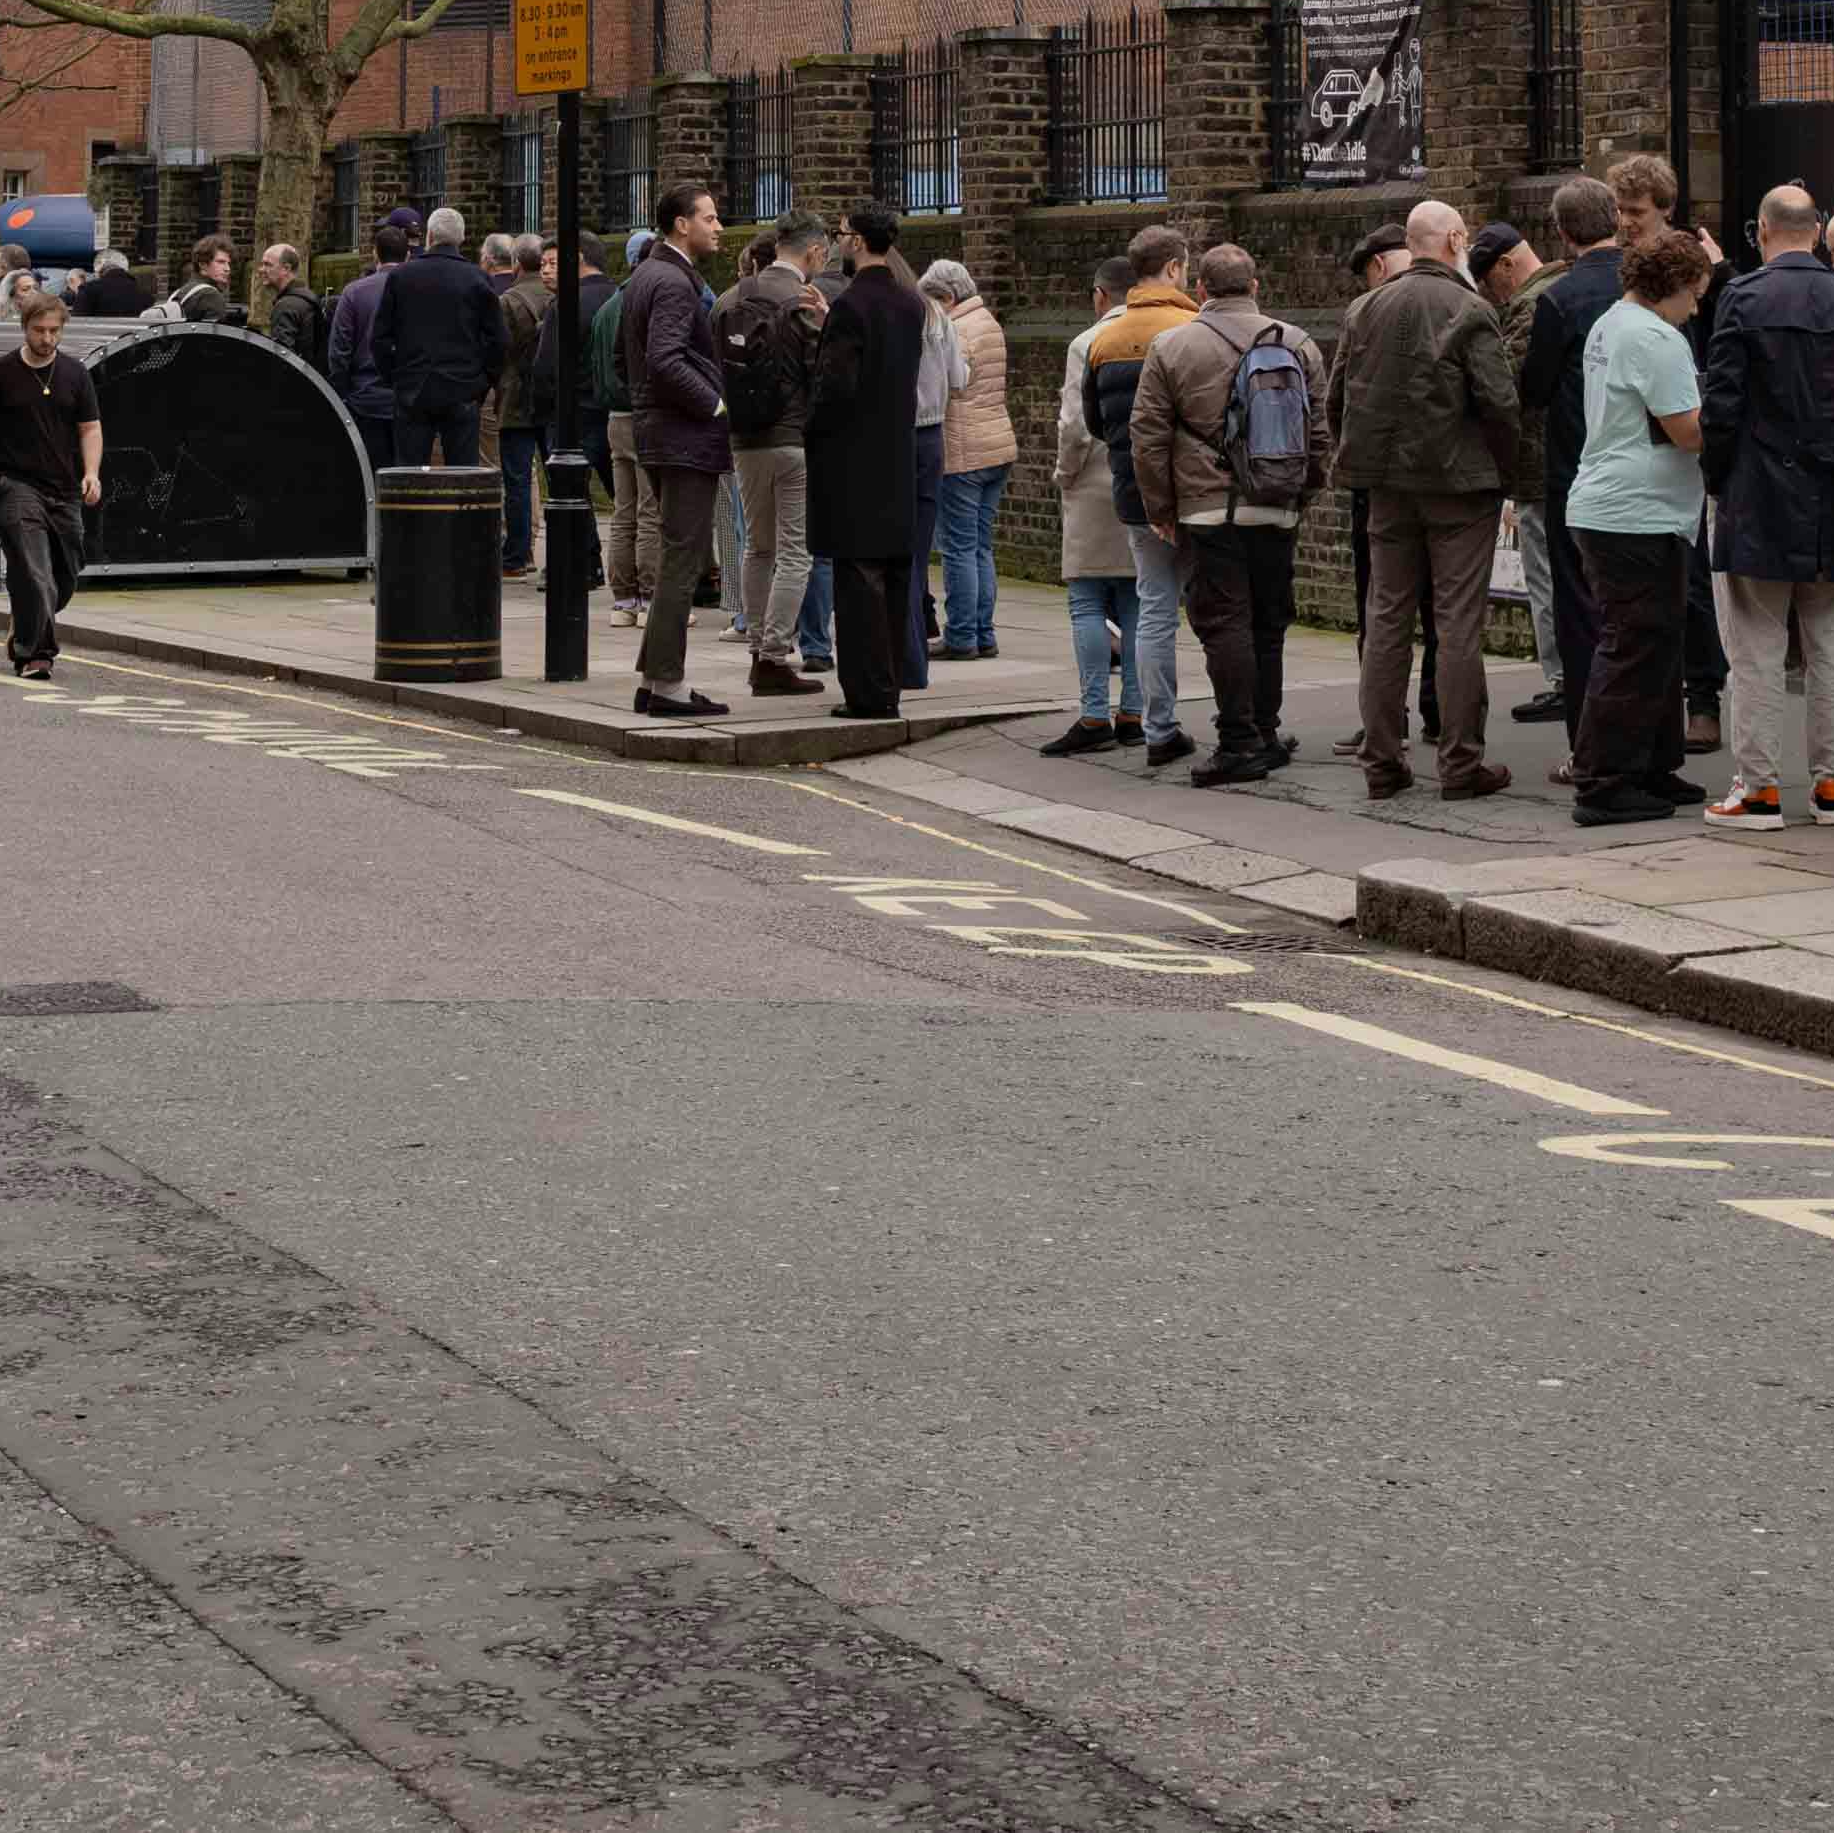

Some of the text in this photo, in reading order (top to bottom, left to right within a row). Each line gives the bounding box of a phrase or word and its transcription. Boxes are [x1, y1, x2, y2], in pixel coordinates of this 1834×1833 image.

[531, 68, 573, 85] markings
[538, 47, 578, 63] entrance
[22, 692, 505, 779] SCHOOL
[800, 873, 1257, 976] KEEP
